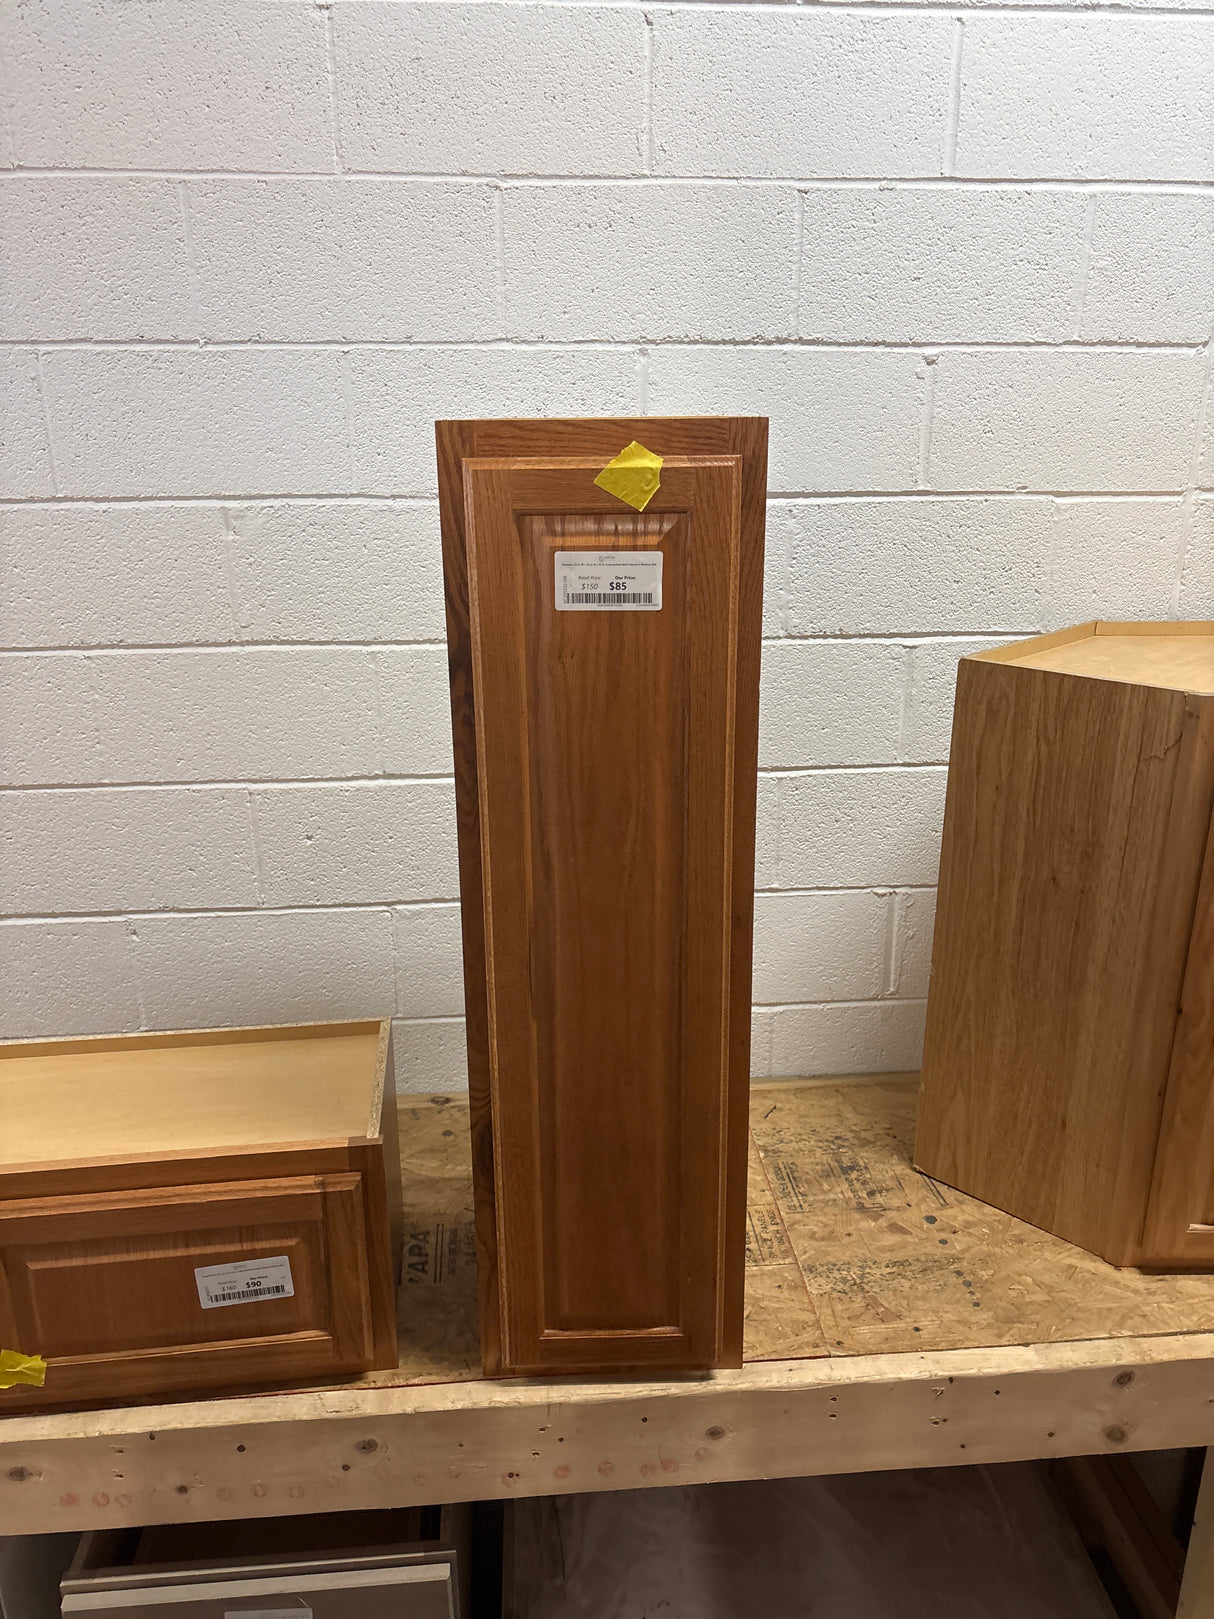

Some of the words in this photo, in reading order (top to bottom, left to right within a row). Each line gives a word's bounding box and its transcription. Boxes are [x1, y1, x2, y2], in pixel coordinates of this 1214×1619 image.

[609, 581, 627, 591] $85
[408, 1231, 430, 1275] APA
[245, 1280, 262, 1289] $90
